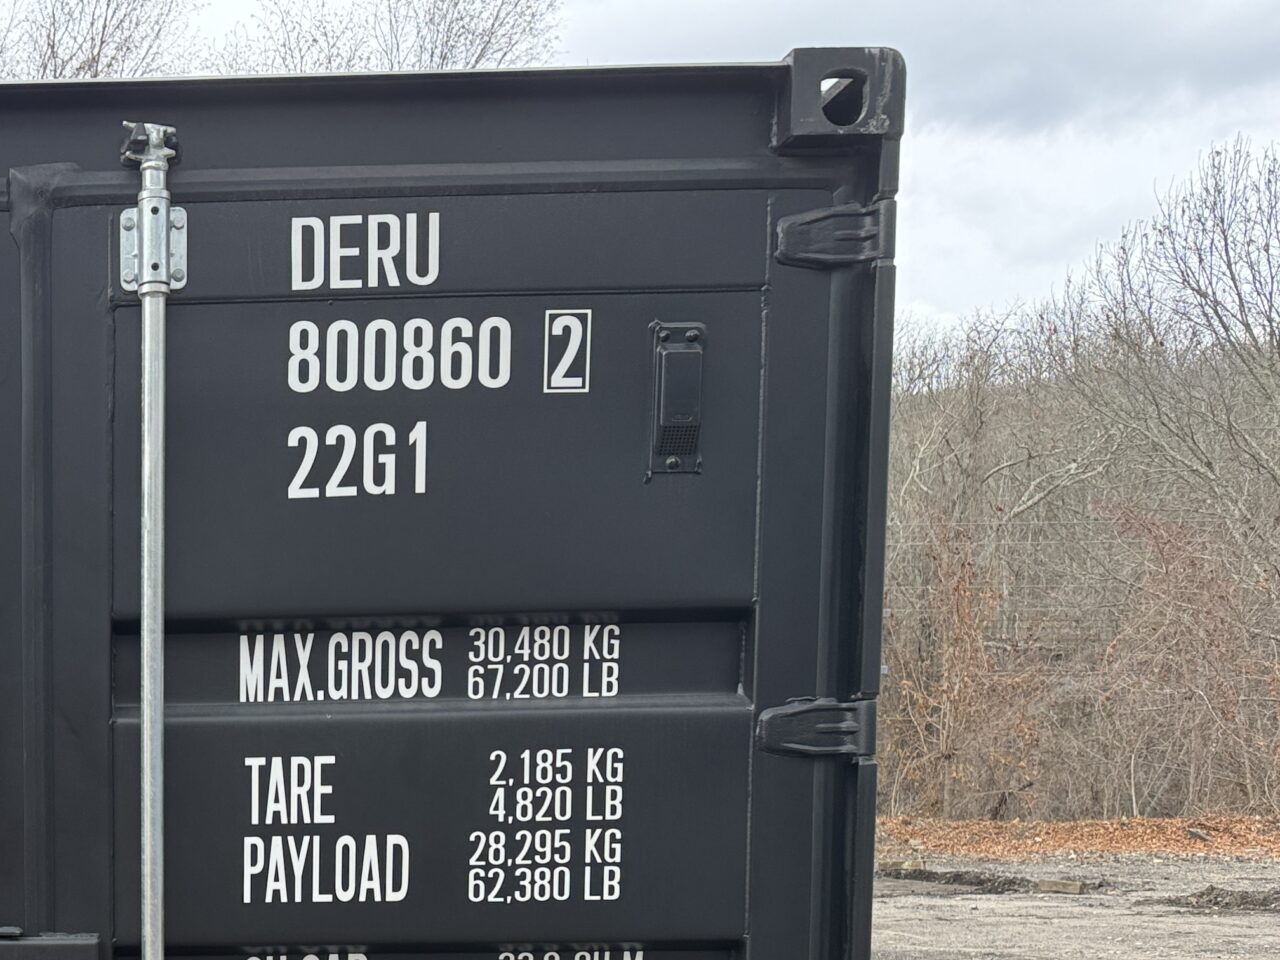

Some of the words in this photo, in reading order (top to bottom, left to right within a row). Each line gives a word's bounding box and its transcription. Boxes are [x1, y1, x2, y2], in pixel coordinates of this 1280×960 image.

[291, 212, 440, 291] DERU
[287, 316, 512, 393] 800860
[550, 315, 583, 388] 2
[287, 421, 427, 499] 22G1
[239, 630, 443, 702] MAX.GROSS
[467, 625, 570, 663] 30,480
[583, 624, 621, 660] KG
[467, 663, 569, 700] 67,200
[582, 661, 619, 698] LB
[244, 755, 336, 825] TARE
[488, 748, 573, 785] 2,185
[586, 747, 624, 783] KG
[488, 786, 572, 823] 4,820
[585, 785, 623, 821] LB
[243, 834, 410, 904] PAYLOAD
[468, 829, 571, 867] 28,295
[584, 828, 622, 864] KG
[468, 867, 570, 904] 62,380
[584, 866, 621, 901] LB
